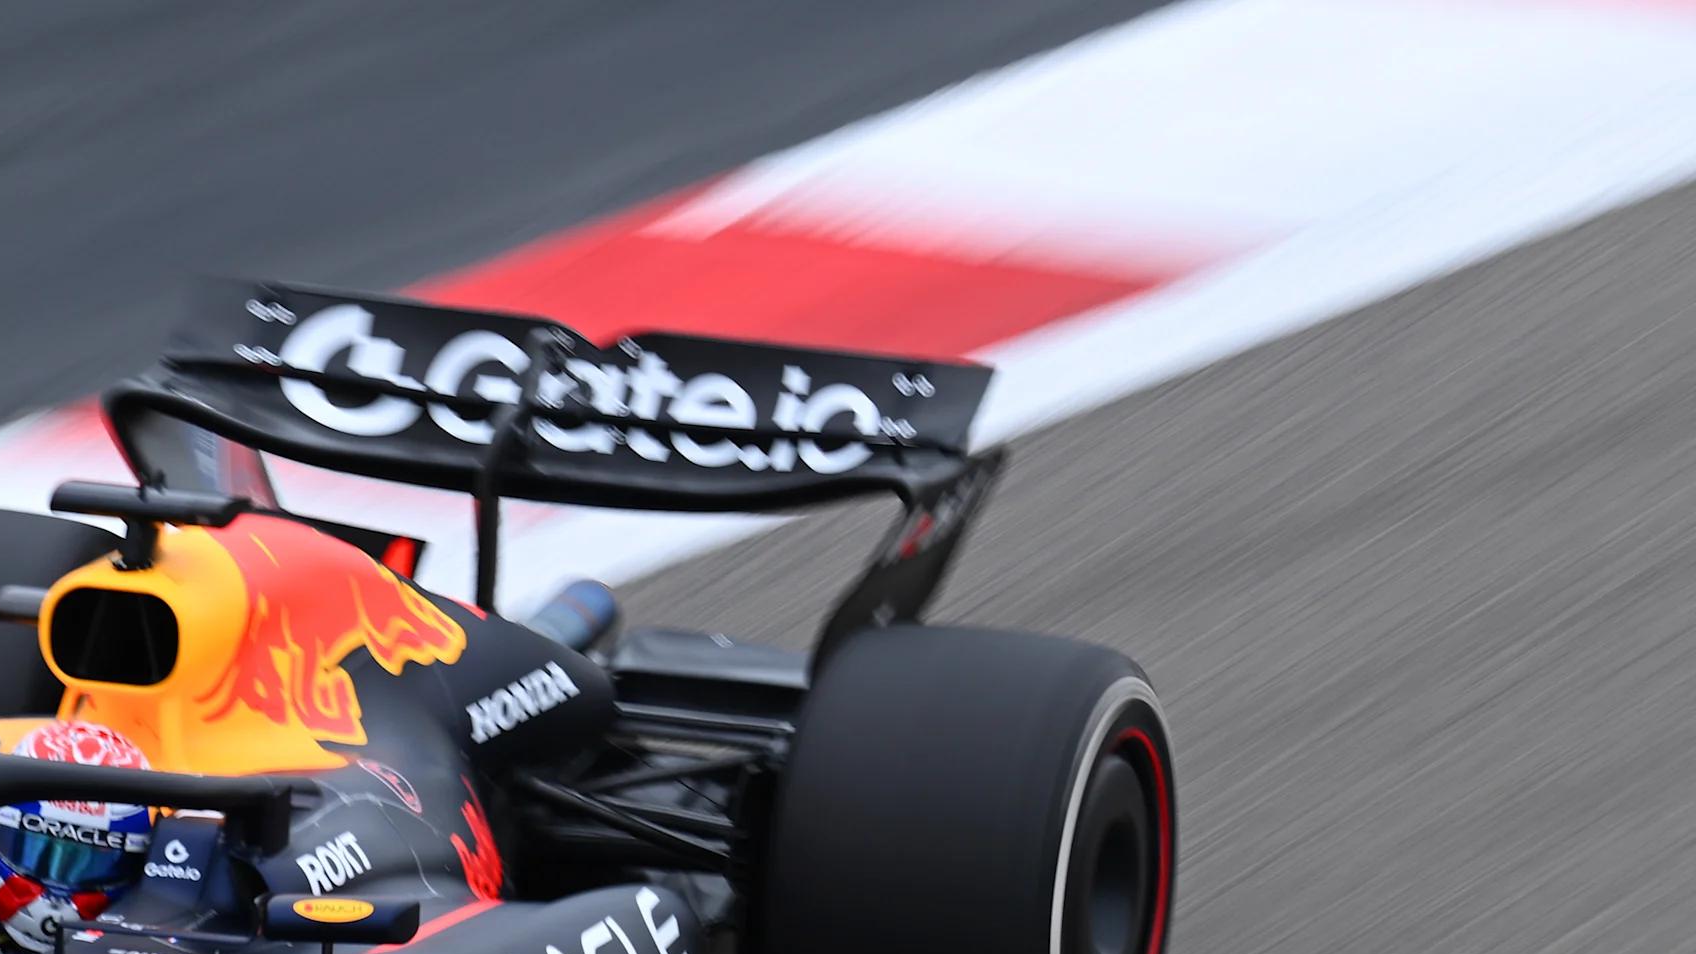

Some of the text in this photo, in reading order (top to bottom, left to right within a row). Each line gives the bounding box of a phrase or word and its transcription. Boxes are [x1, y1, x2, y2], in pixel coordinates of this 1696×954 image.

[466, 661, 581, 744] HONDA
[22, 813, 124, 849] ORACLE
[144, 862, 202, 881] Gate.io
[297, 831, 372, 896] ROKT
